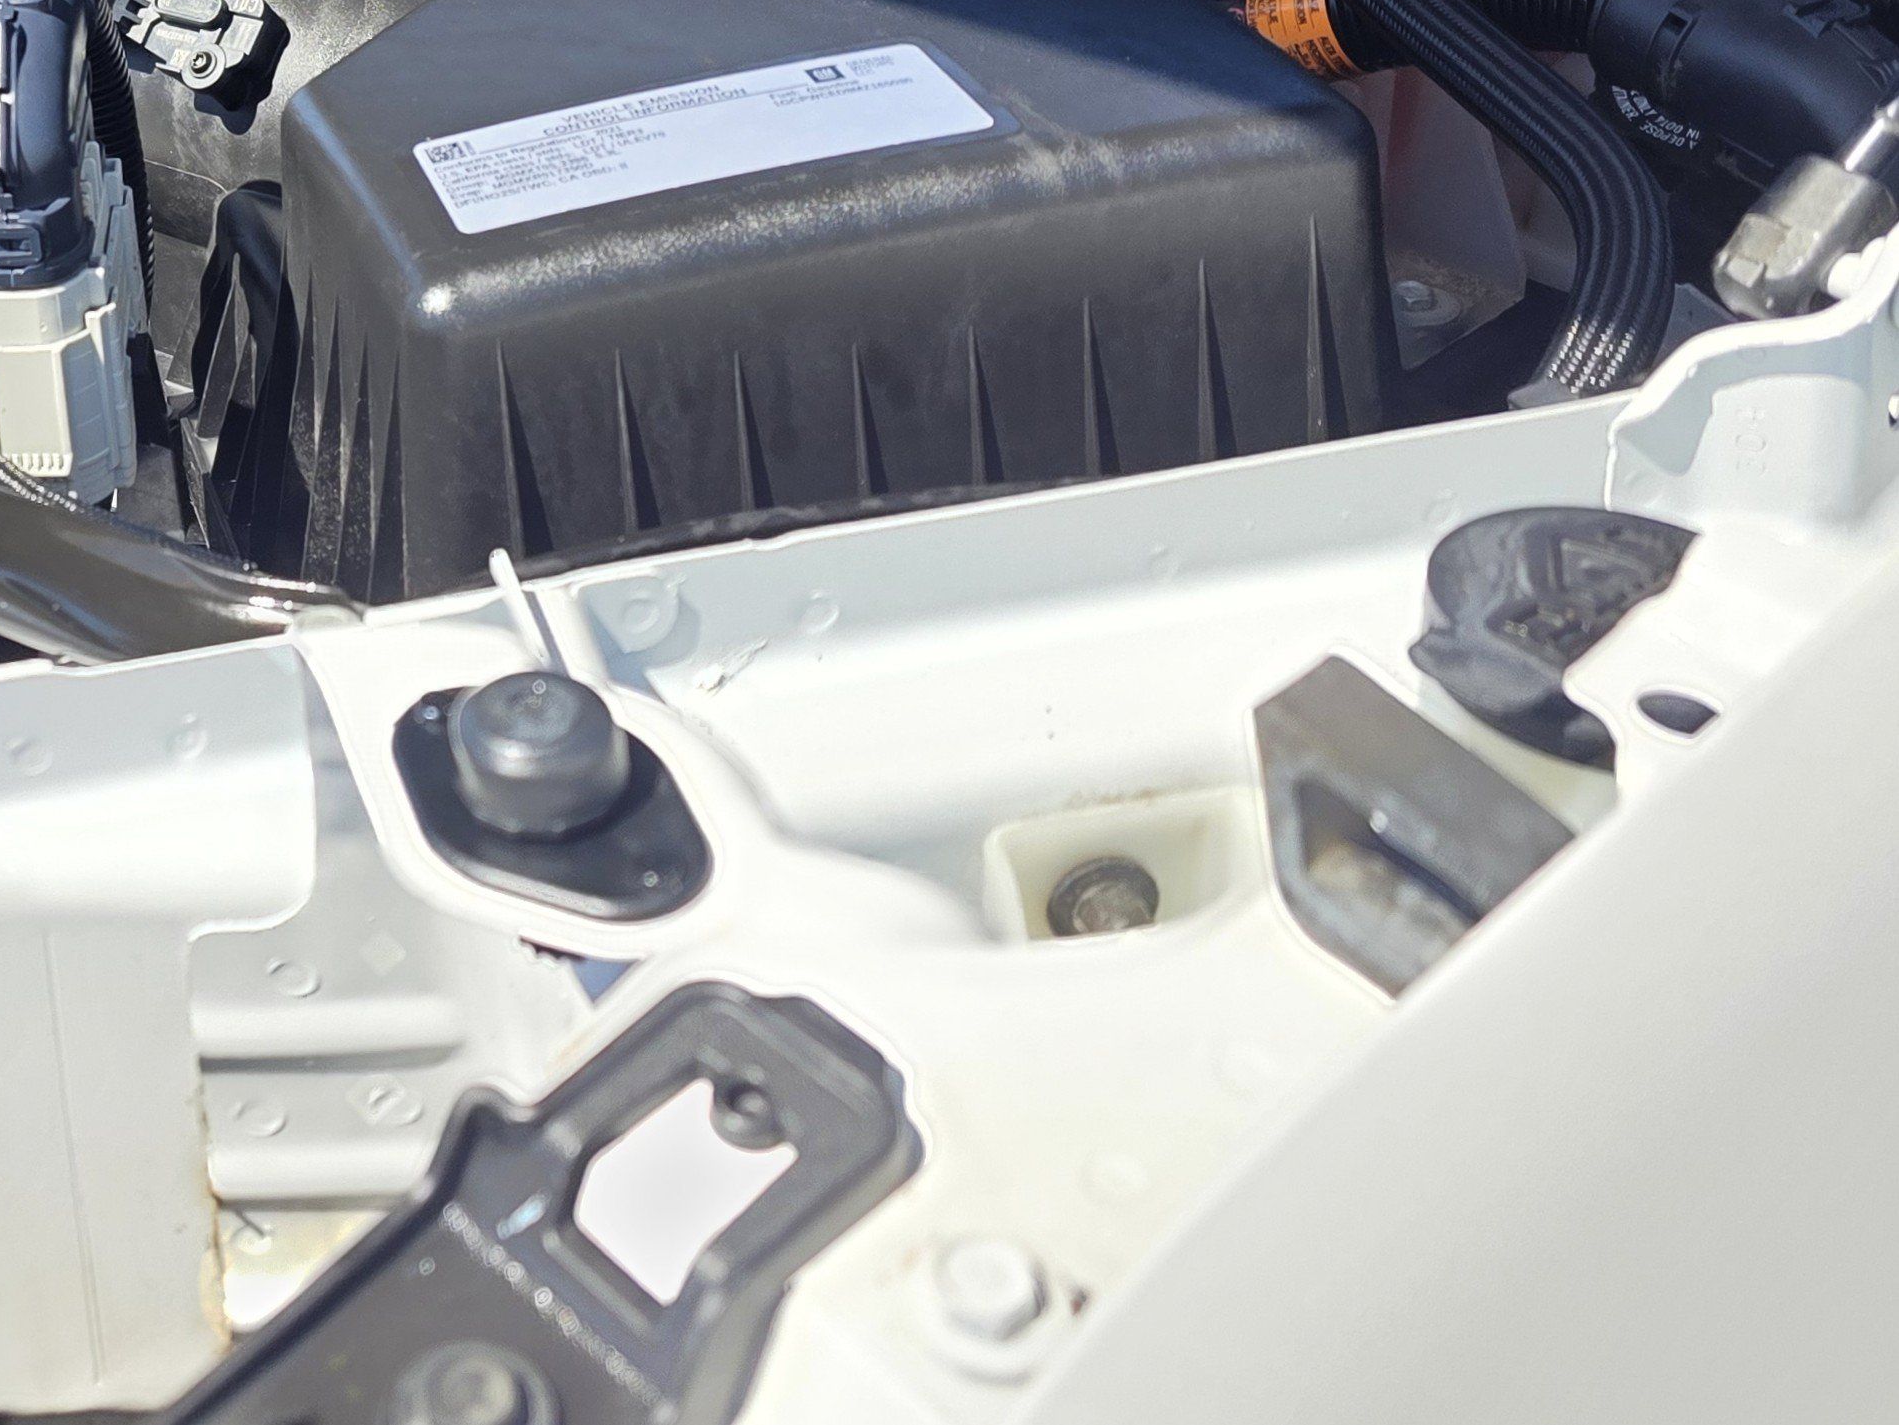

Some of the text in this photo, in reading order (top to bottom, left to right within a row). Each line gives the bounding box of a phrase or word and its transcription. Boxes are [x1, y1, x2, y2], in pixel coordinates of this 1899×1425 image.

[543, 114, 628, 136] CONTROL
[630, 87, 747, 119] INFORMATION
[561, 84, 720, 123] VEHICLE EMISSION
